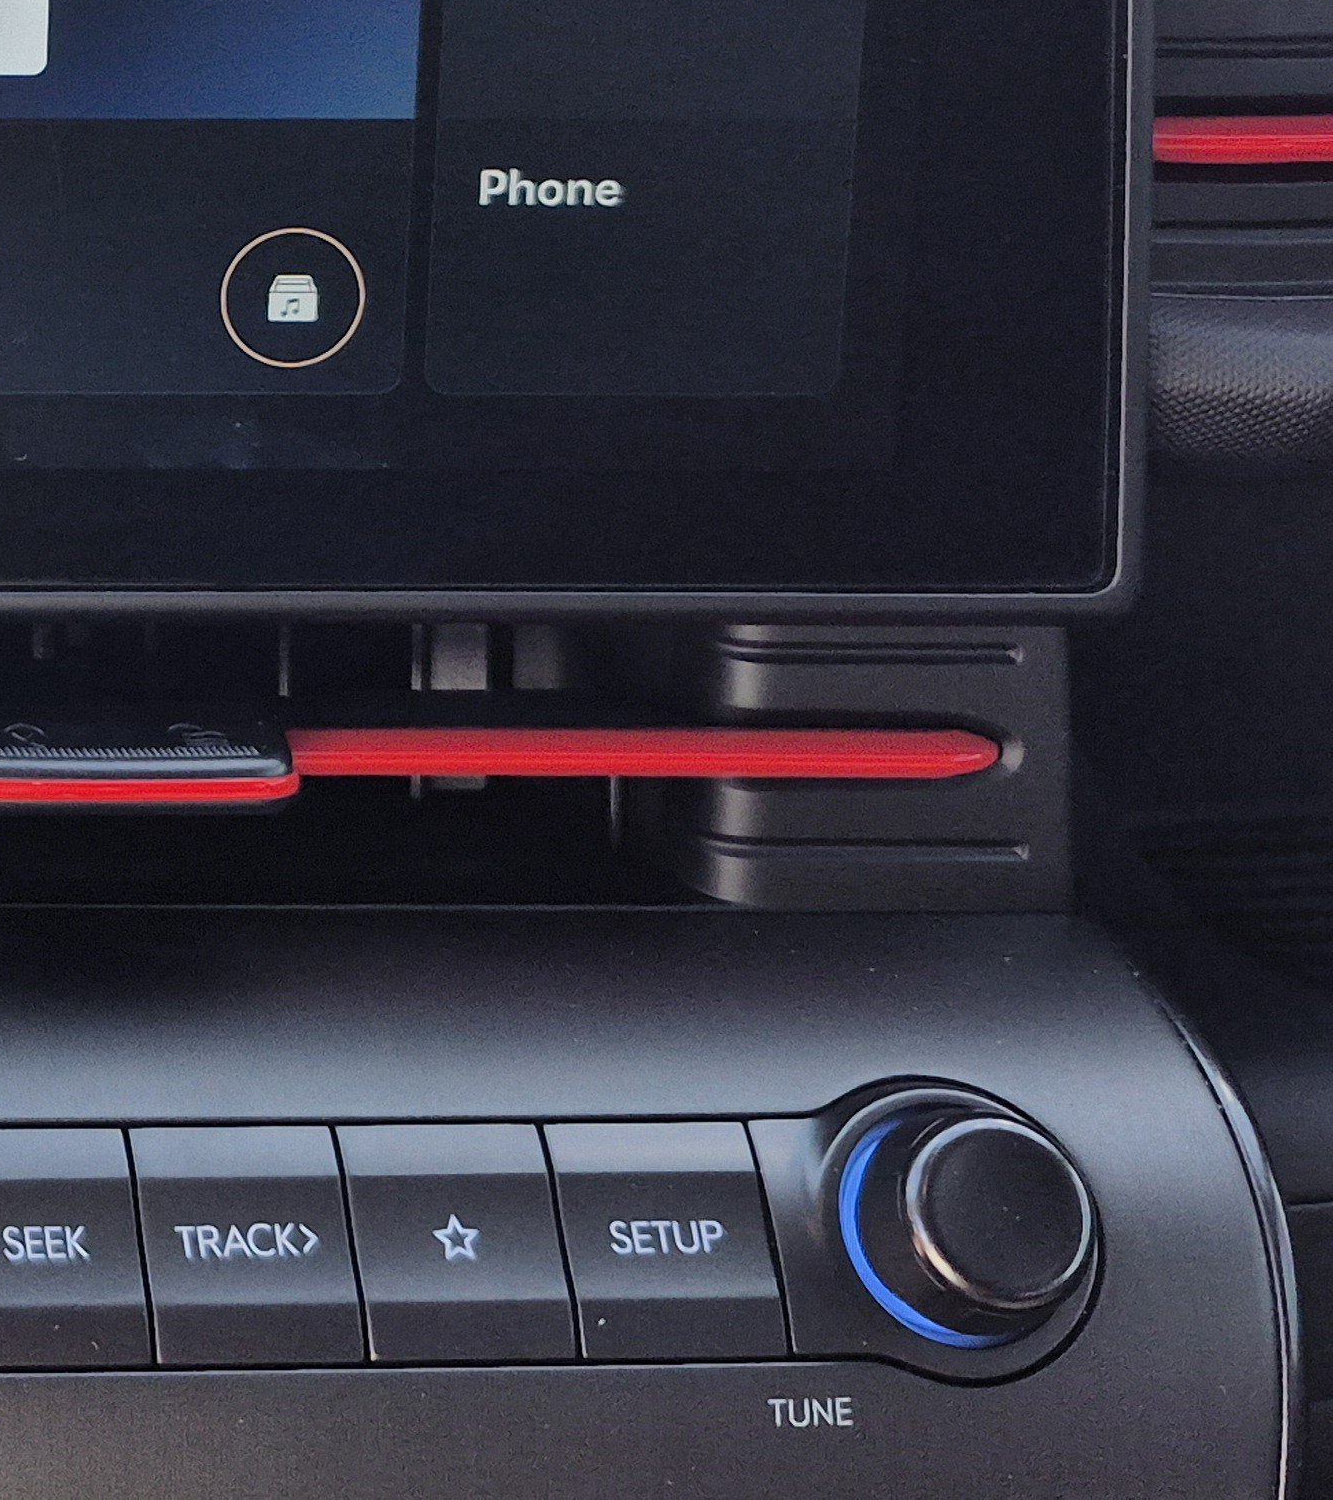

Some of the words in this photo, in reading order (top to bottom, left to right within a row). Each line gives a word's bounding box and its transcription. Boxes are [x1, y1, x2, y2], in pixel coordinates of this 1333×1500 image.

[478, 169, 625, 207] Phone
[608, 1219, 726, 1256] SETUP
[767, 1397, 854, 1429] TUNE
